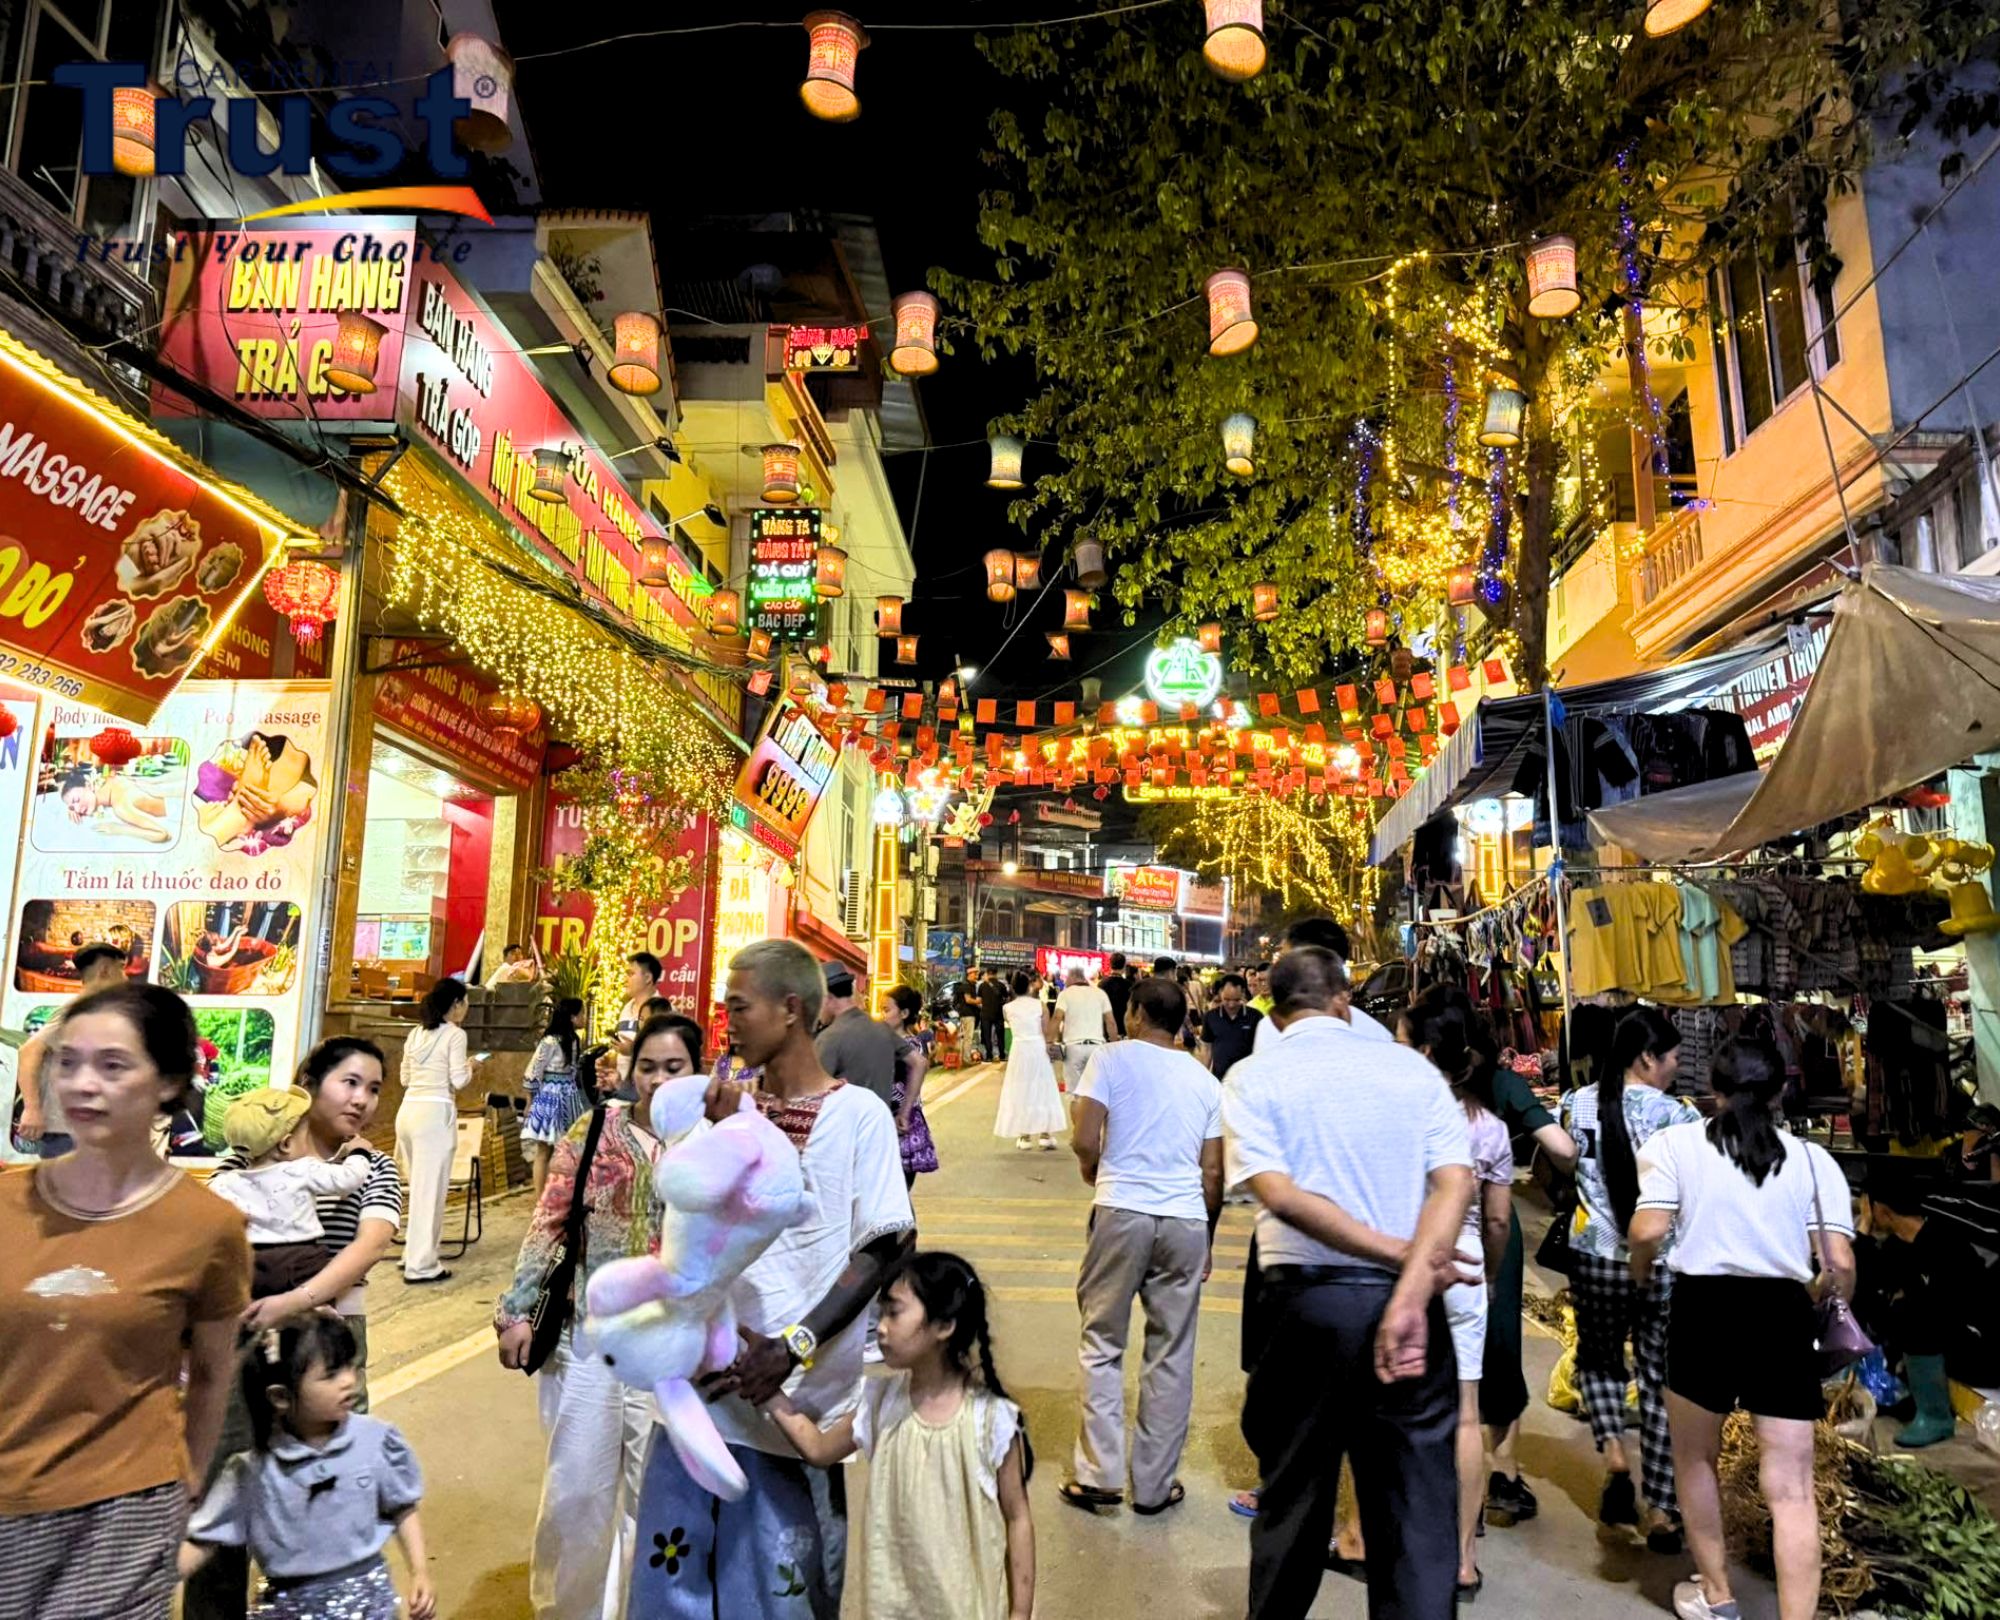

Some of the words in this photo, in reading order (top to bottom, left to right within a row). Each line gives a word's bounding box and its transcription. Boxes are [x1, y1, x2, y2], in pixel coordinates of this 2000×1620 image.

[424, 281, 455, 352] BÁN
[455, 320, 495, 398] HÀNG
[830, 328, 858, 349] BẠC
[236, 317, 301, 395] TRẢ
[451, 407, 481, 470] GÓP
[0, 422, 136, 532] MASSAGE
[762, 516, 794, 535] VÀNG
[797, 519, 810, 535] TA
[757, 538, 789, 559] VÀNG
[791, 539, 812, 559] TÂY
[757, 561, 779, 577] ĐÁ
[781, 561, 811, 577] QUÝ
[764, 601, 783, 610] CAO
[758, 613, 781, 632] BẠC
[232, 624, 270, 658] HÒNG
[50, 675, 83, 697] 266
[54, 705, 88, 729] Body
[760, 761, 810, 821] 9999
[1140, 784, 1166, 799] See
[1168, 786, 1191, 798] You
[1191, 785, 1231, 799] Again
[63, 867, 109, 890] Tắm
[142, 866, 203, 891] thuốc
[209, 871, 248, 891] dao
[255, 868, 282, 891] đỏ
[670, 964, 697, 983] cầu
